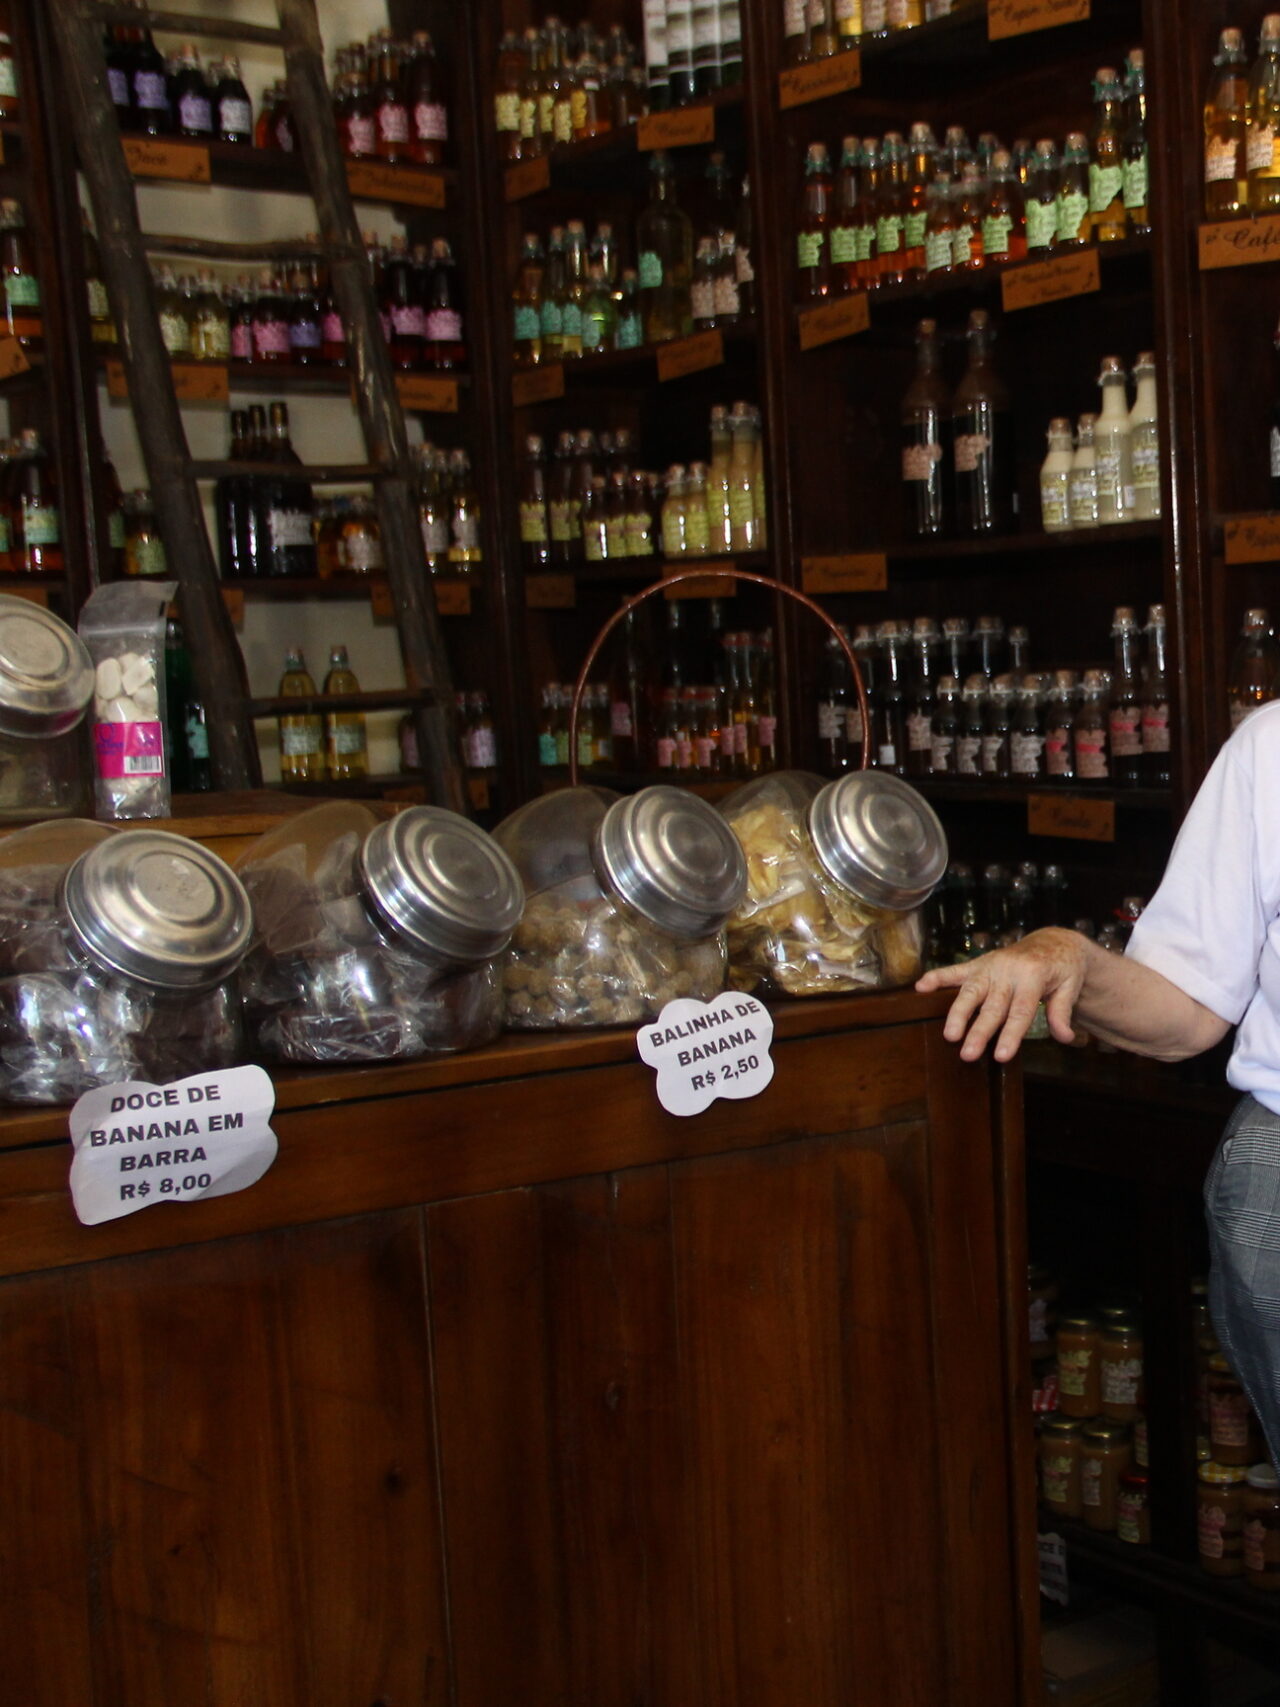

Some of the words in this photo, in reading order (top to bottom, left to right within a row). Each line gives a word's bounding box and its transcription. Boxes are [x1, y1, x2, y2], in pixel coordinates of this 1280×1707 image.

[650, 1009, 734, 1047] BALINHA
[735, 1001, 761, 1017] DE
[677, 1028, 757, 1067] BANANA
[691, 1070, 717, 1091] R$
[721, 1054, 760, 1080] 2,50
[110, 1089, 180, 1113] DOCE
[188, 1085, 221, 1104] DE
[90, 1118, 200, 1147] BANANA
[208, 1112, 244, 1132] EM
[120, 1147, 208, 1172] BARRA
[120, 1180, 151, 1201] R$
[159, 1173, 212, 1196] 8,00
